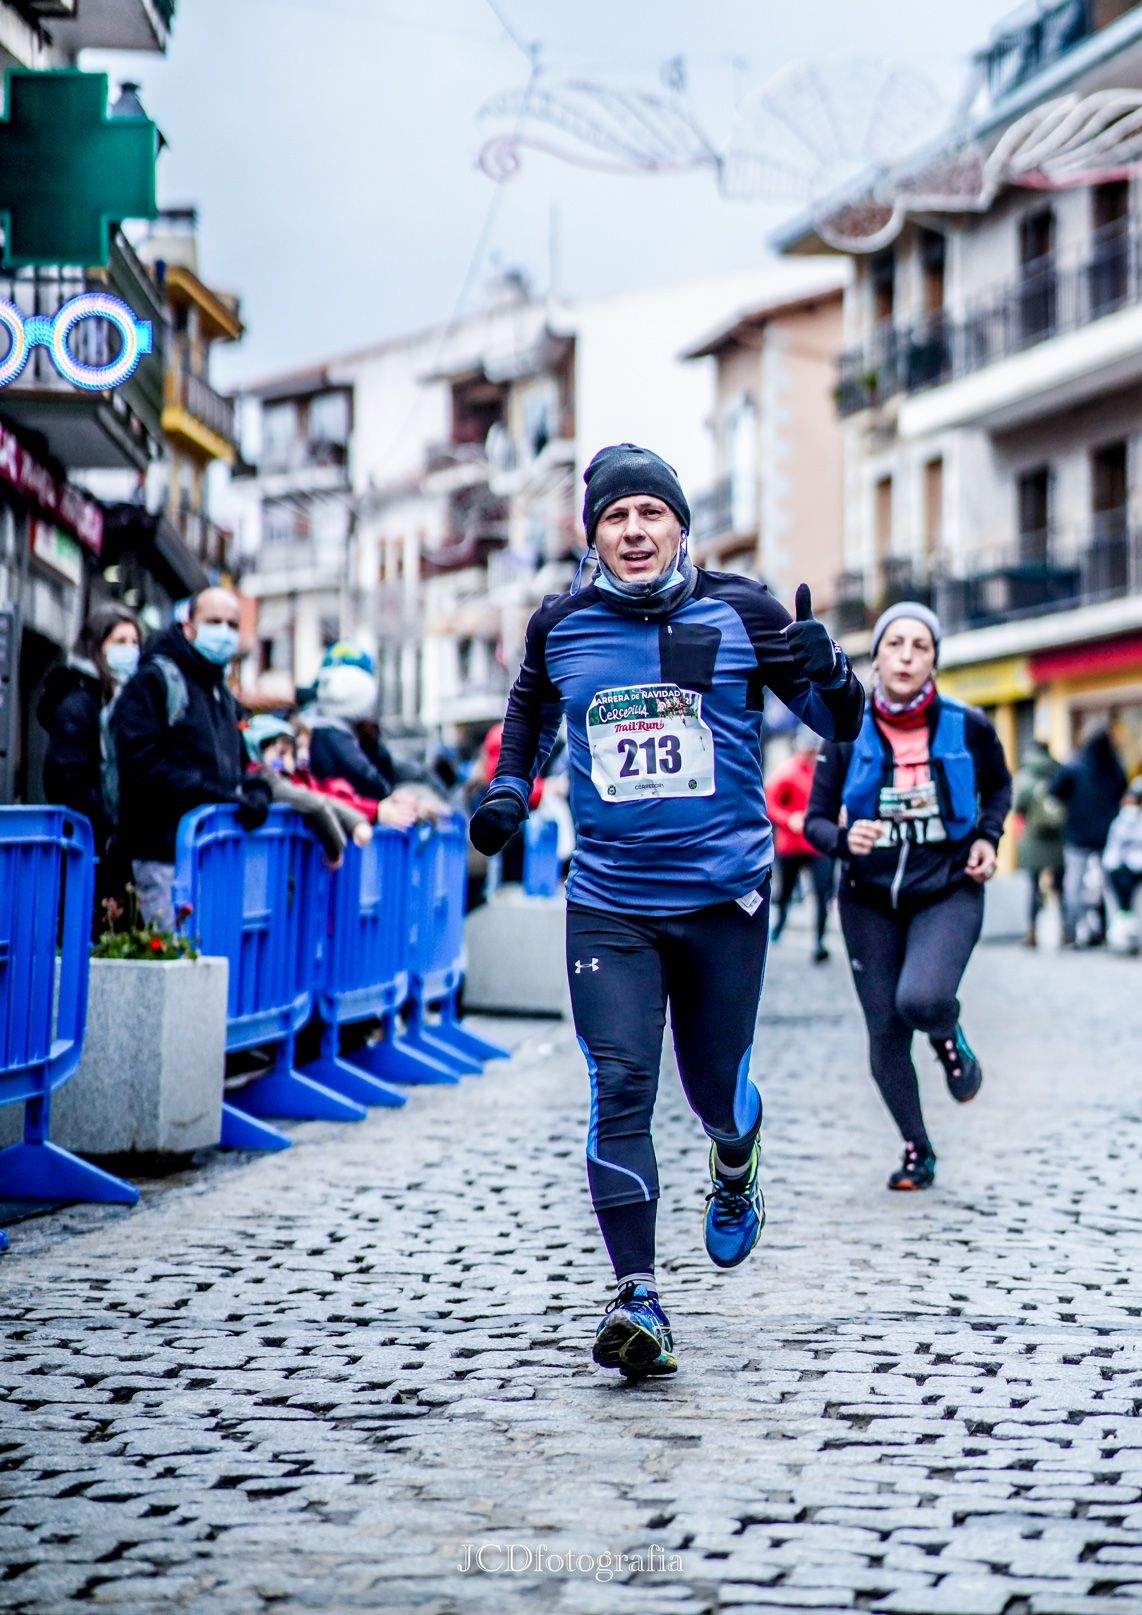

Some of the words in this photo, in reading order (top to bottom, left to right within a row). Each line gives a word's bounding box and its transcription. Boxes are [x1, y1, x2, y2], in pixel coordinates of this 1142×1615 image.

[596, 694, 629, 704] ARRERA
[642, 690, 680, 699] NAVIDAD
[617, 734, 682, 778] 213
